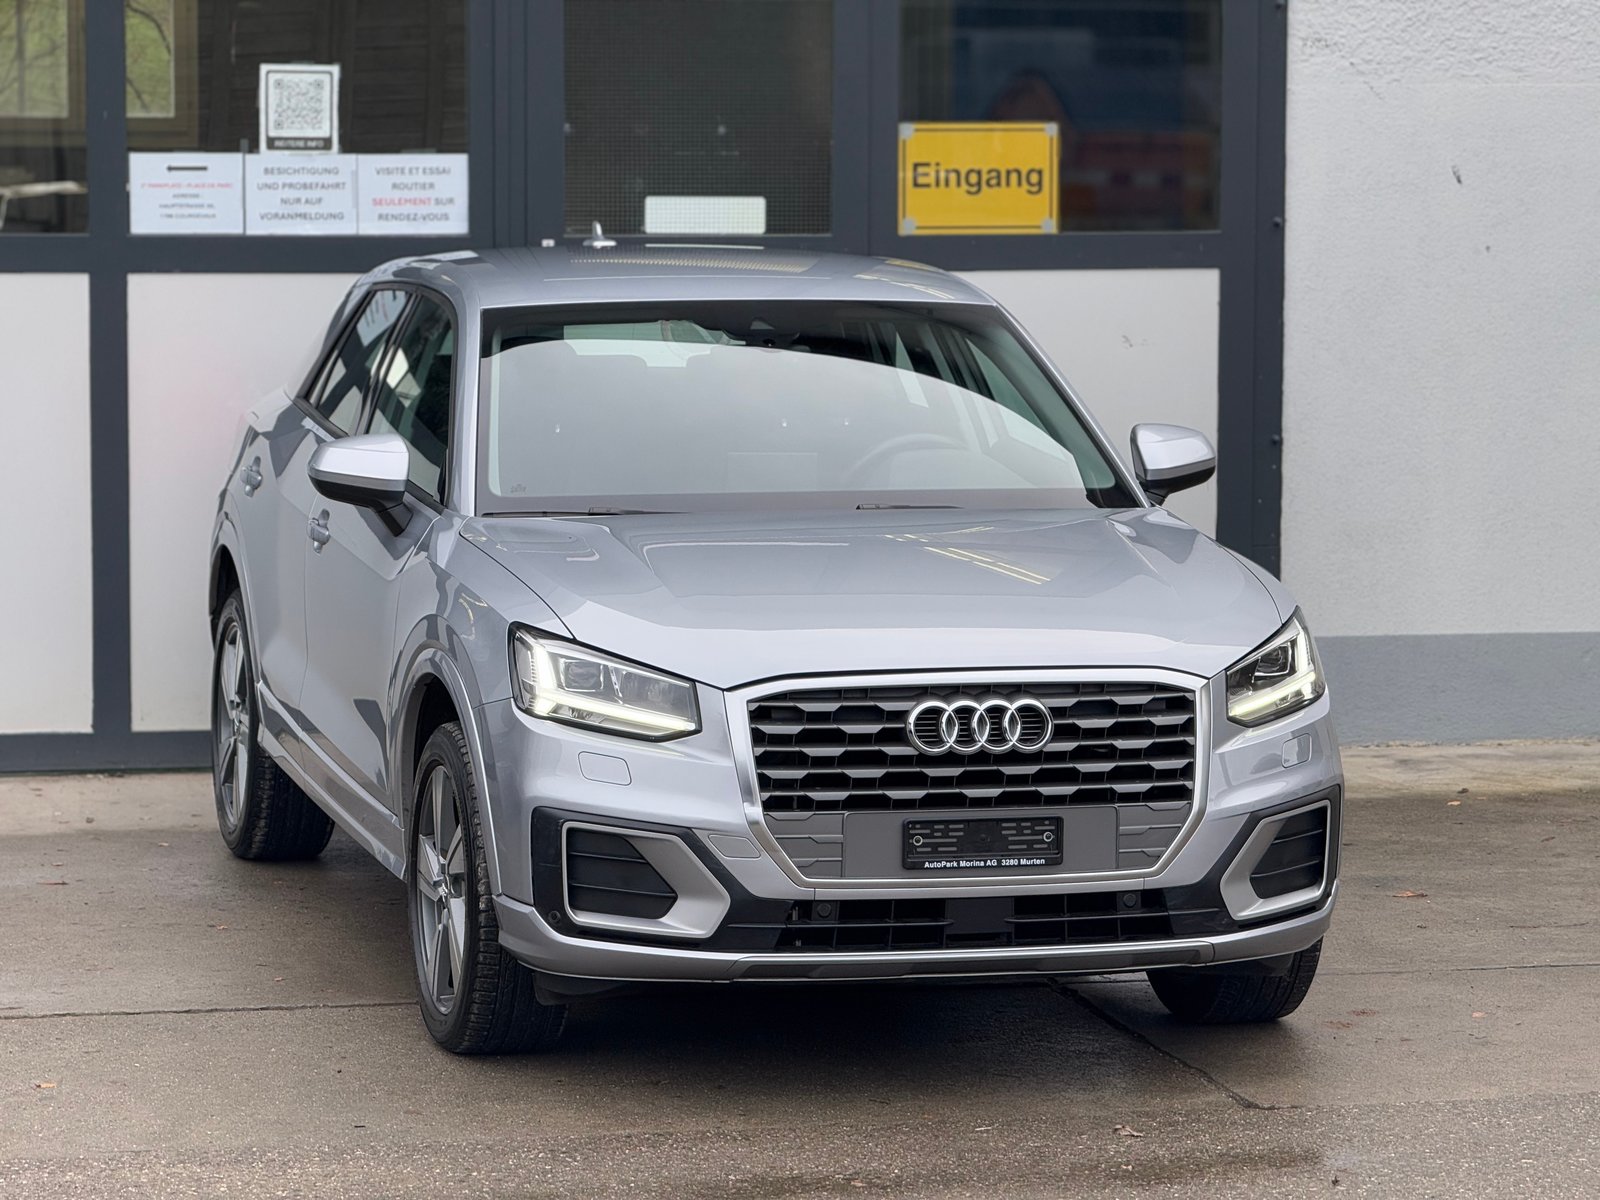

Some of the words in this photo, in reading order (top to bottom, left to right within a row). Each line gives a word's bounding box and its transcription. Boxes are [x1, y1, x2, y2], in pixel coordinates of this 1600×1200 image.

[263, 166, 340, 176] BESICHTIGUNG
[375, 166, 406, 176] VISITE
[408, 166, 420, 176] ET
[422, 166, 451, 176] ESSAI
[912, 162, 1043, 196] Eingang
[256, 182, 280, 191] UND
[282, 181, 347, 191] PROBEFAHRT
[391, 182, 435, 191] ROUTIER
[280, 197, 302, 206] NUR
[304, 197, 323, 206] AUF
[372, 197, 432, 207] SEULEMENT
[434, 197, 455, 206] SUR
[259, 211, 345, 221] VORANMELDUNG
[377, 212, 450, 222] RENDEZ-VOUS
[924, 860, 958, 869] AutoPark
[959, 859, 985, 867] Morina
[986, 859, 998, 867] AG
[1001, 858, 1019, 866] 3280
[1020, 858, 1046, 866] Murten
